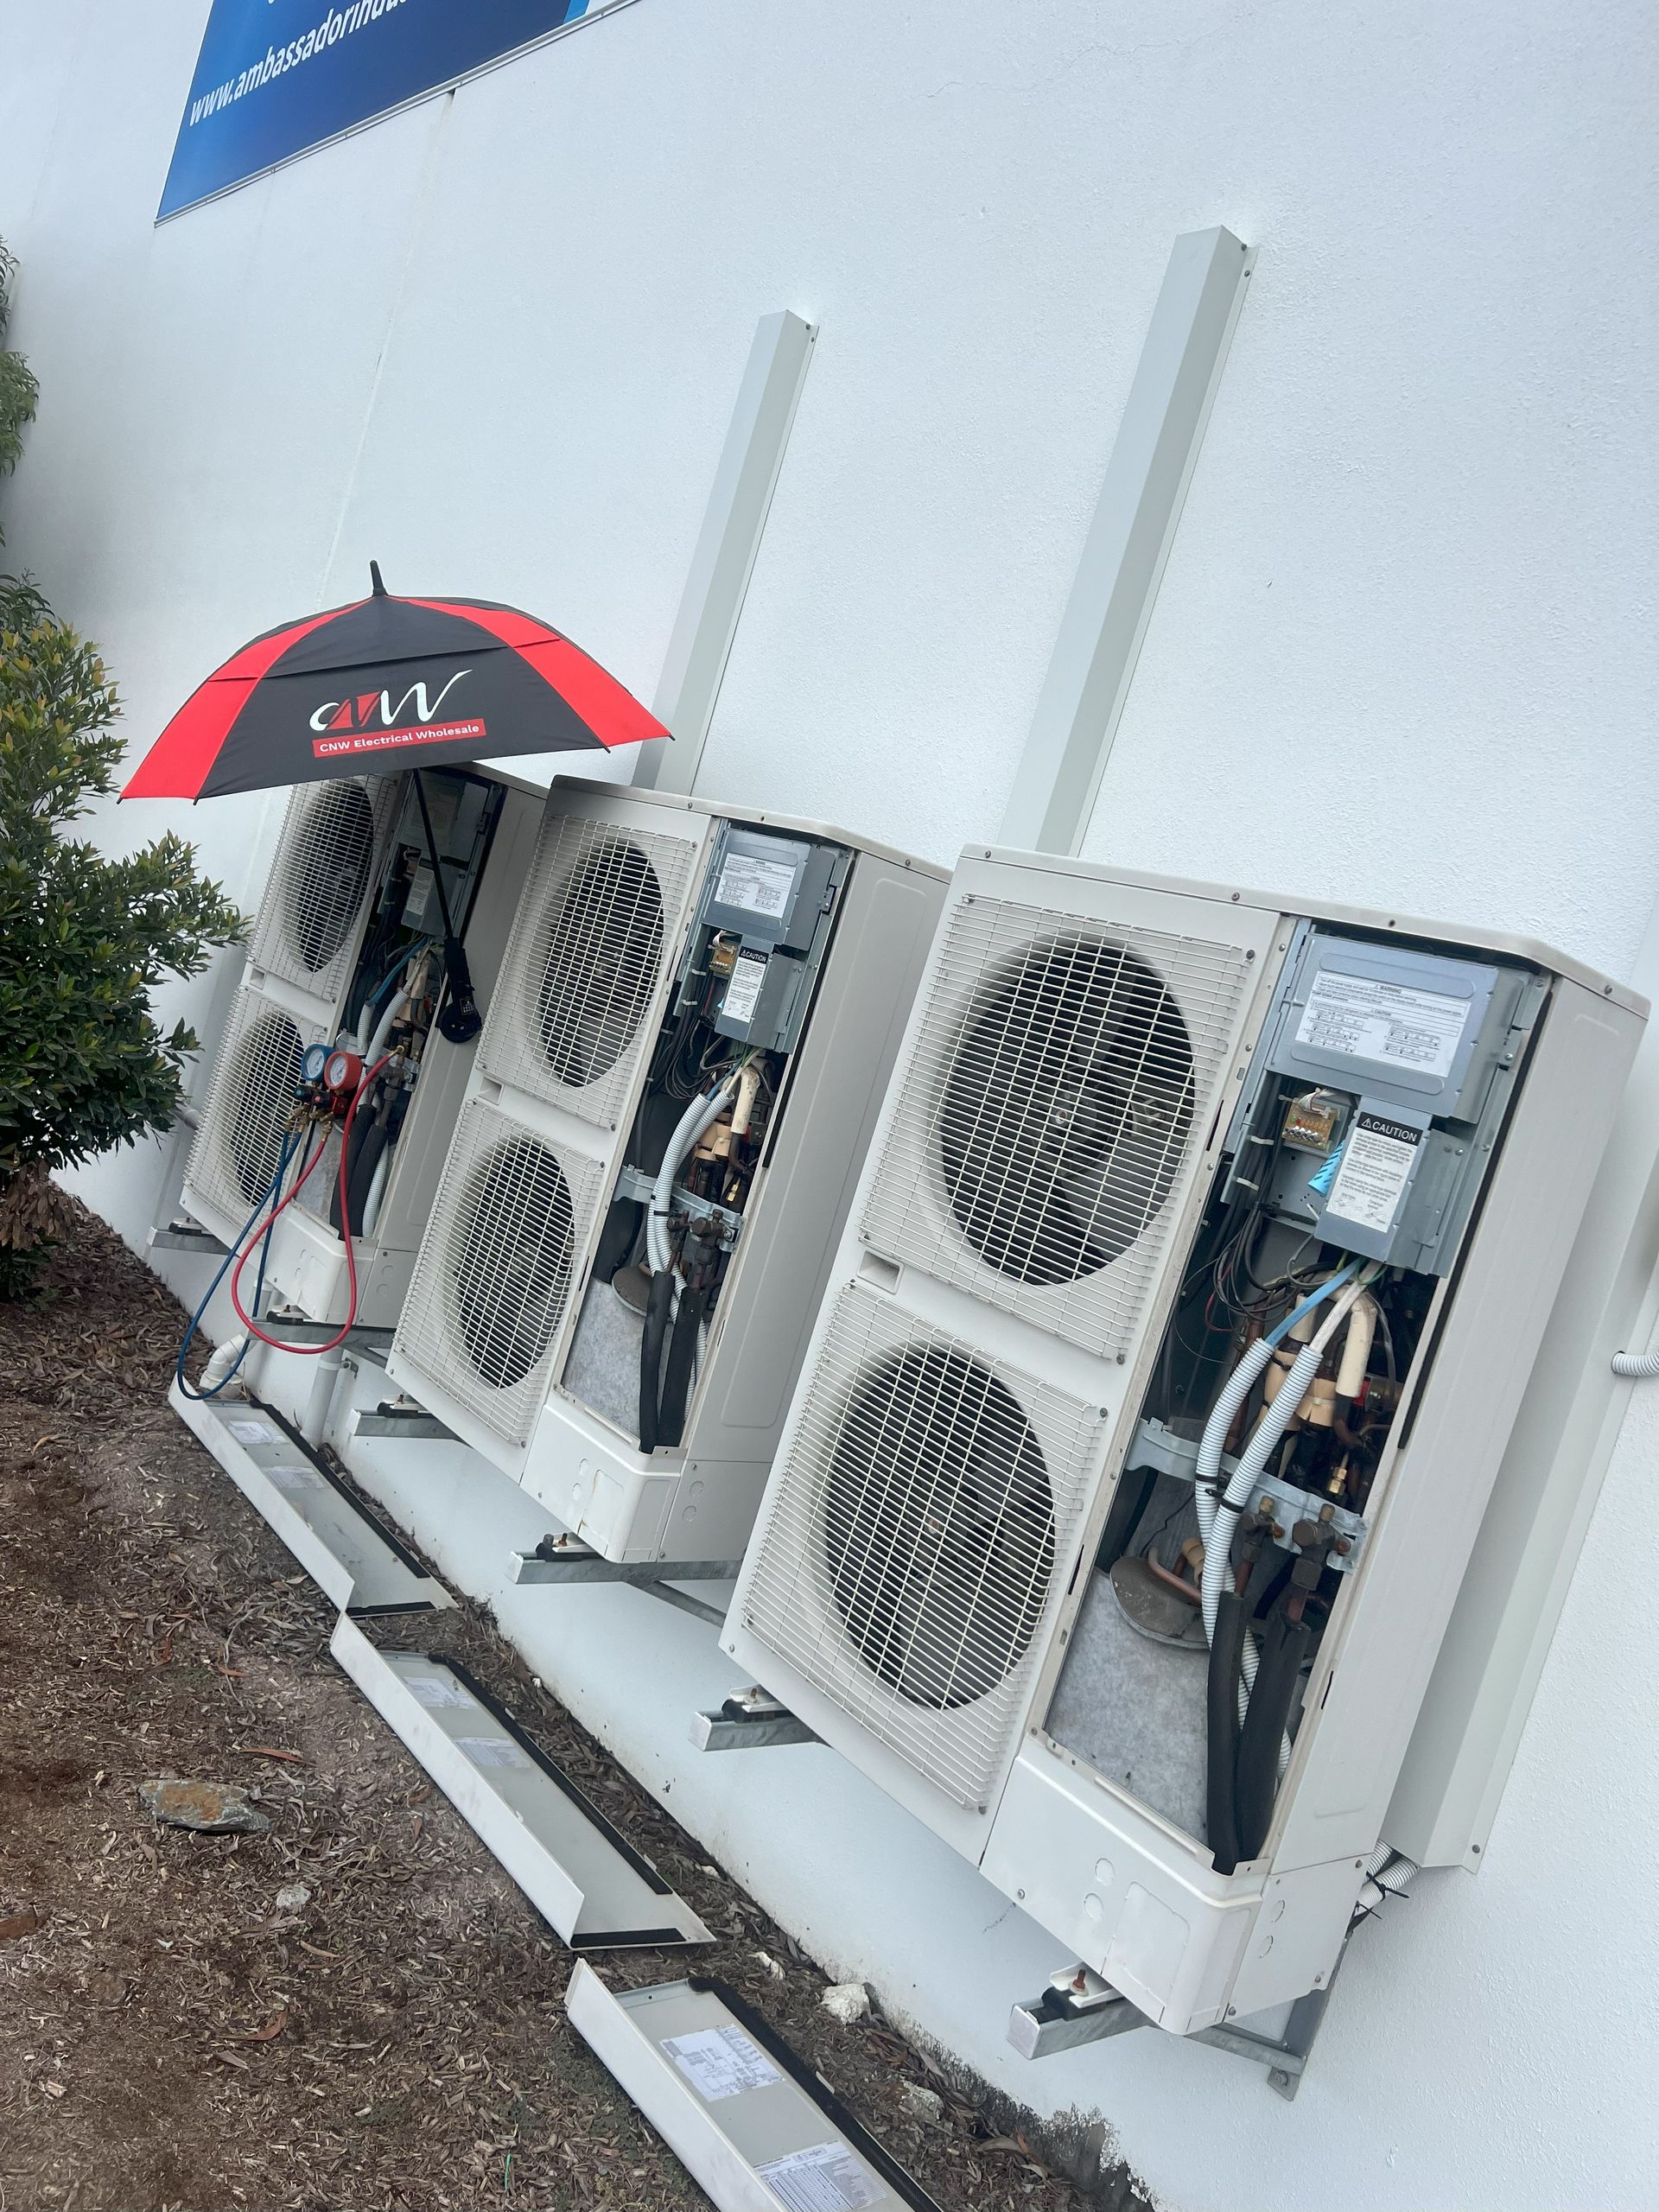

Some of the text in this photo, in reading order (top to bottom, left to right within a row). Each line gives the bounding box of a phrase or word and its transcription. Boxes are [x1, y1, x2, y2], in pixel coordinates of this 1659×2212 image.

[189, 0, 407, 126] www.ambassadorind
[320, 724, 480, 753] CNW Electrical Wholesale
[746, 950, 767, 963] CAUTION
[1371, 1120, 1418, 1143] CAUTION
